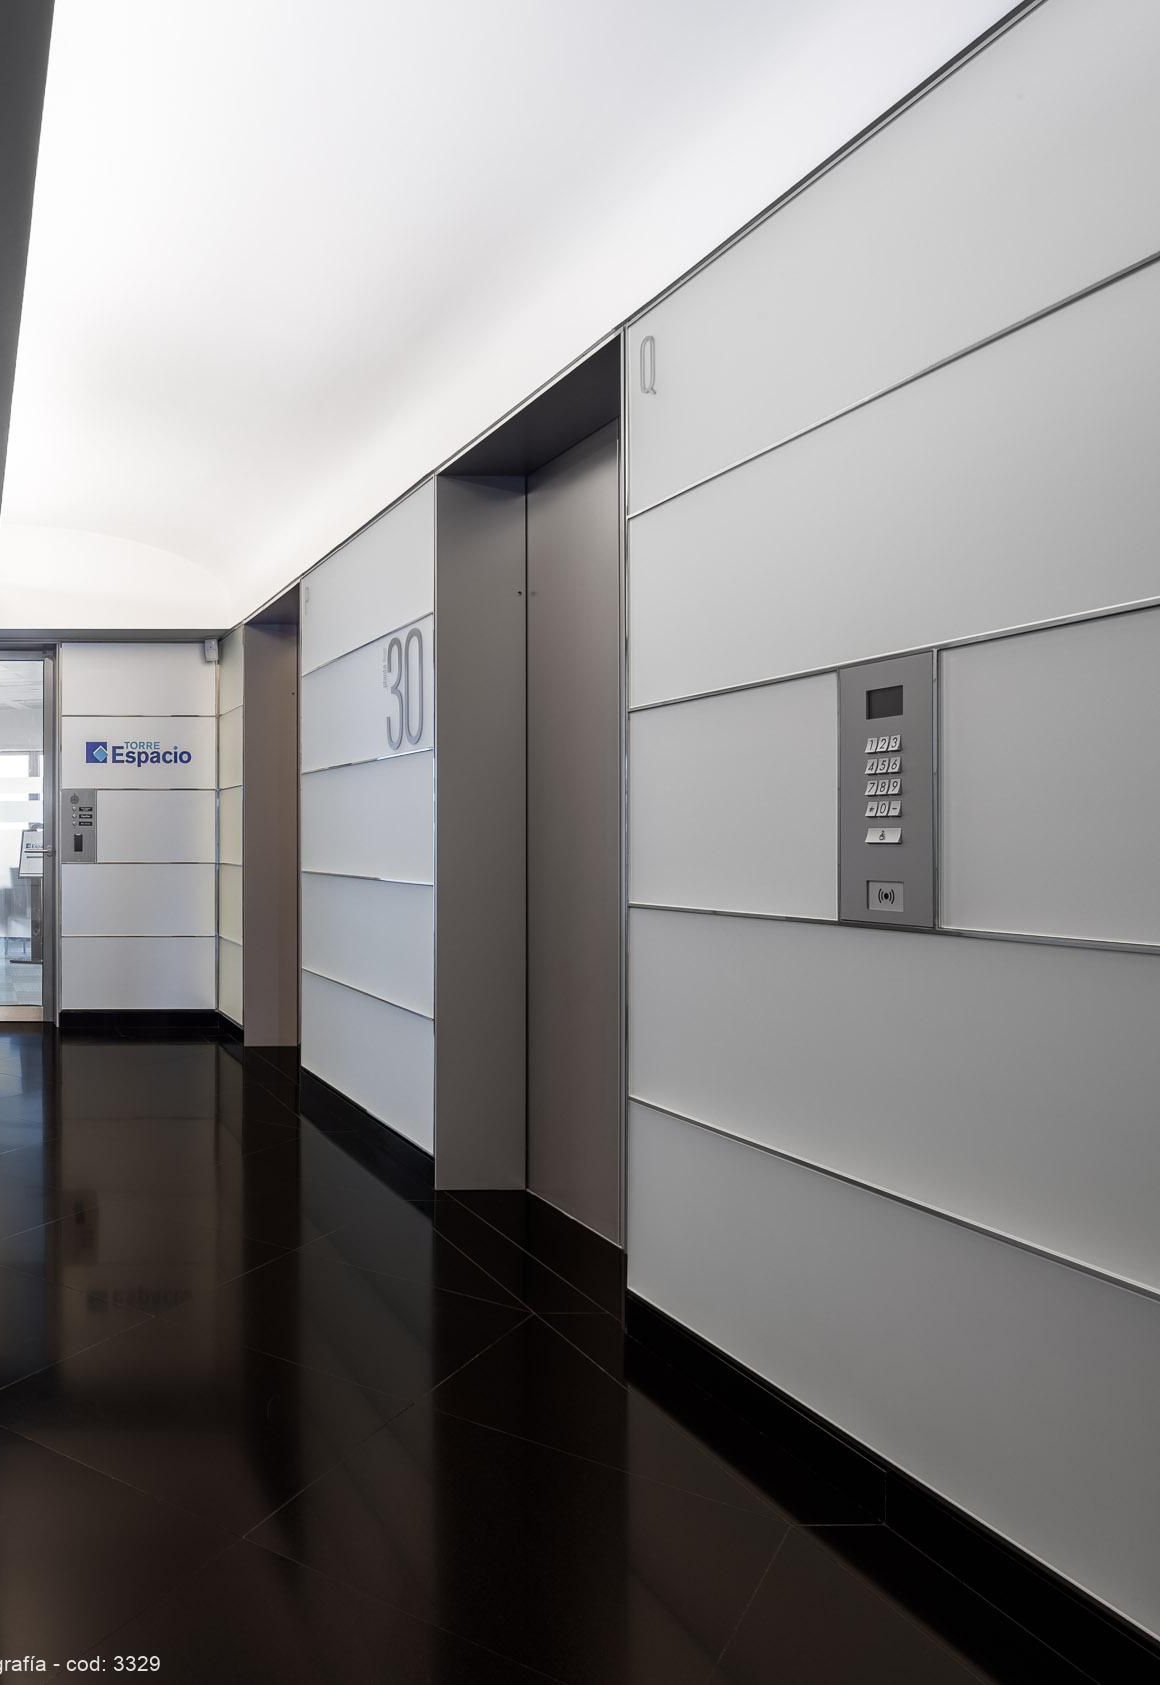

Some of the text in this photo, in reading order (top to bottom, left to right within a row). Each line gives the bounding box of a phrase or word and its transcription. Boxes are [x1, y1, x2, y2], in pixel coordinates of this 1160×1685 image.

[640, 335, 656, 394] Q
[386, 627, 423, 750] 30
[111, 745, 192, 768] Espacio
[124, 741, 161, 750] TORRE
